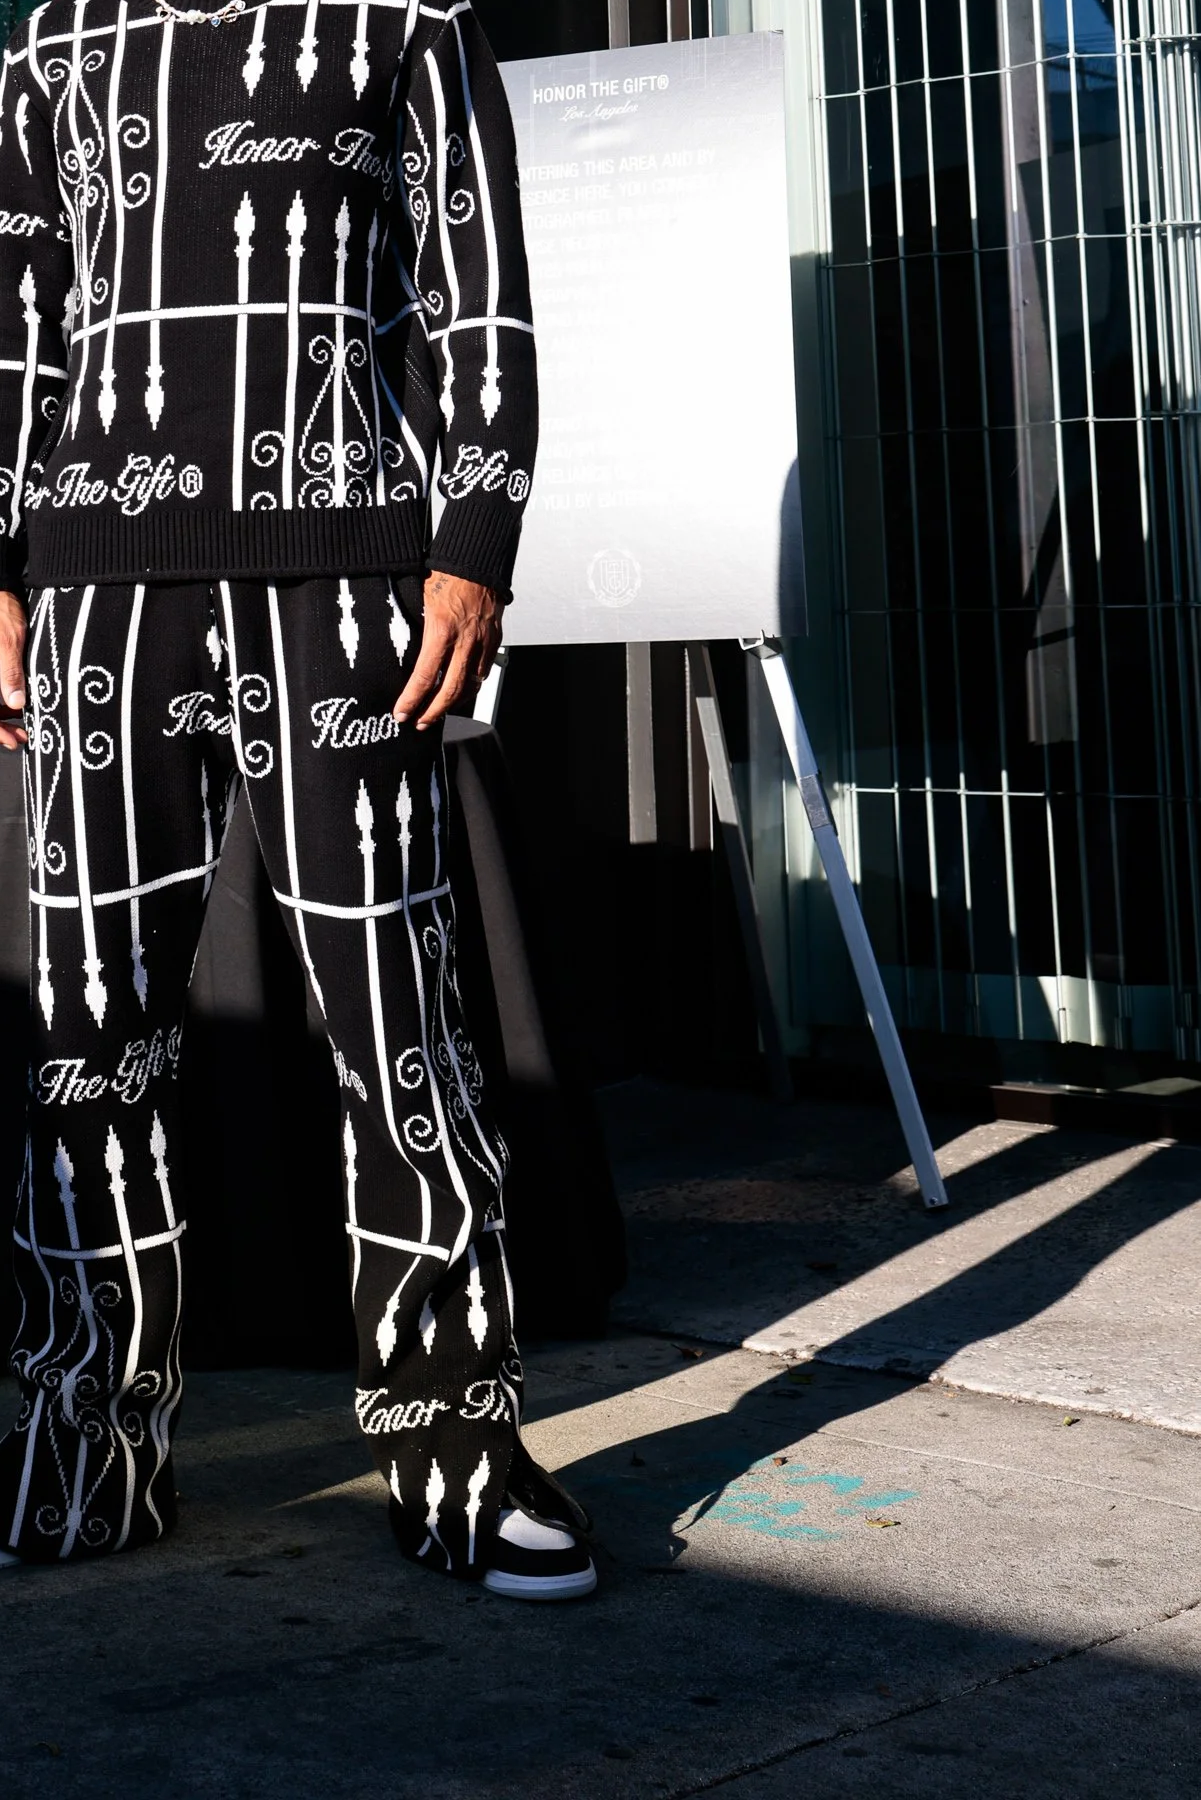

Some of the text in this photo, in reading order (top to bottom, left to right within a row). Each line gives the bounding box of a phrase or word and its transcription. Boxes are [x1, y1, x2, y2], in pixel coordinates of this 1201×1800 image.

[533, 84, 586, 104] HONOR
[590, 80, 619, 98] THE
[560, 100, 639, 122] Los Angeles
[198, 119, 321, 169] Honor
[519, 163, 579, 183] NTERING
[583, 159, 615, 176] THIS
[619, 154, 657, 173] AREA
[661, 151, 692, 168] AND
[520, 188, 570, 208] ESENCE
[574, 183, 613, 202] HERE
[52, 462, 109, 508] The
[37, 1058, 107, 1105] The
[459, 1379, 511, 1423] Th
